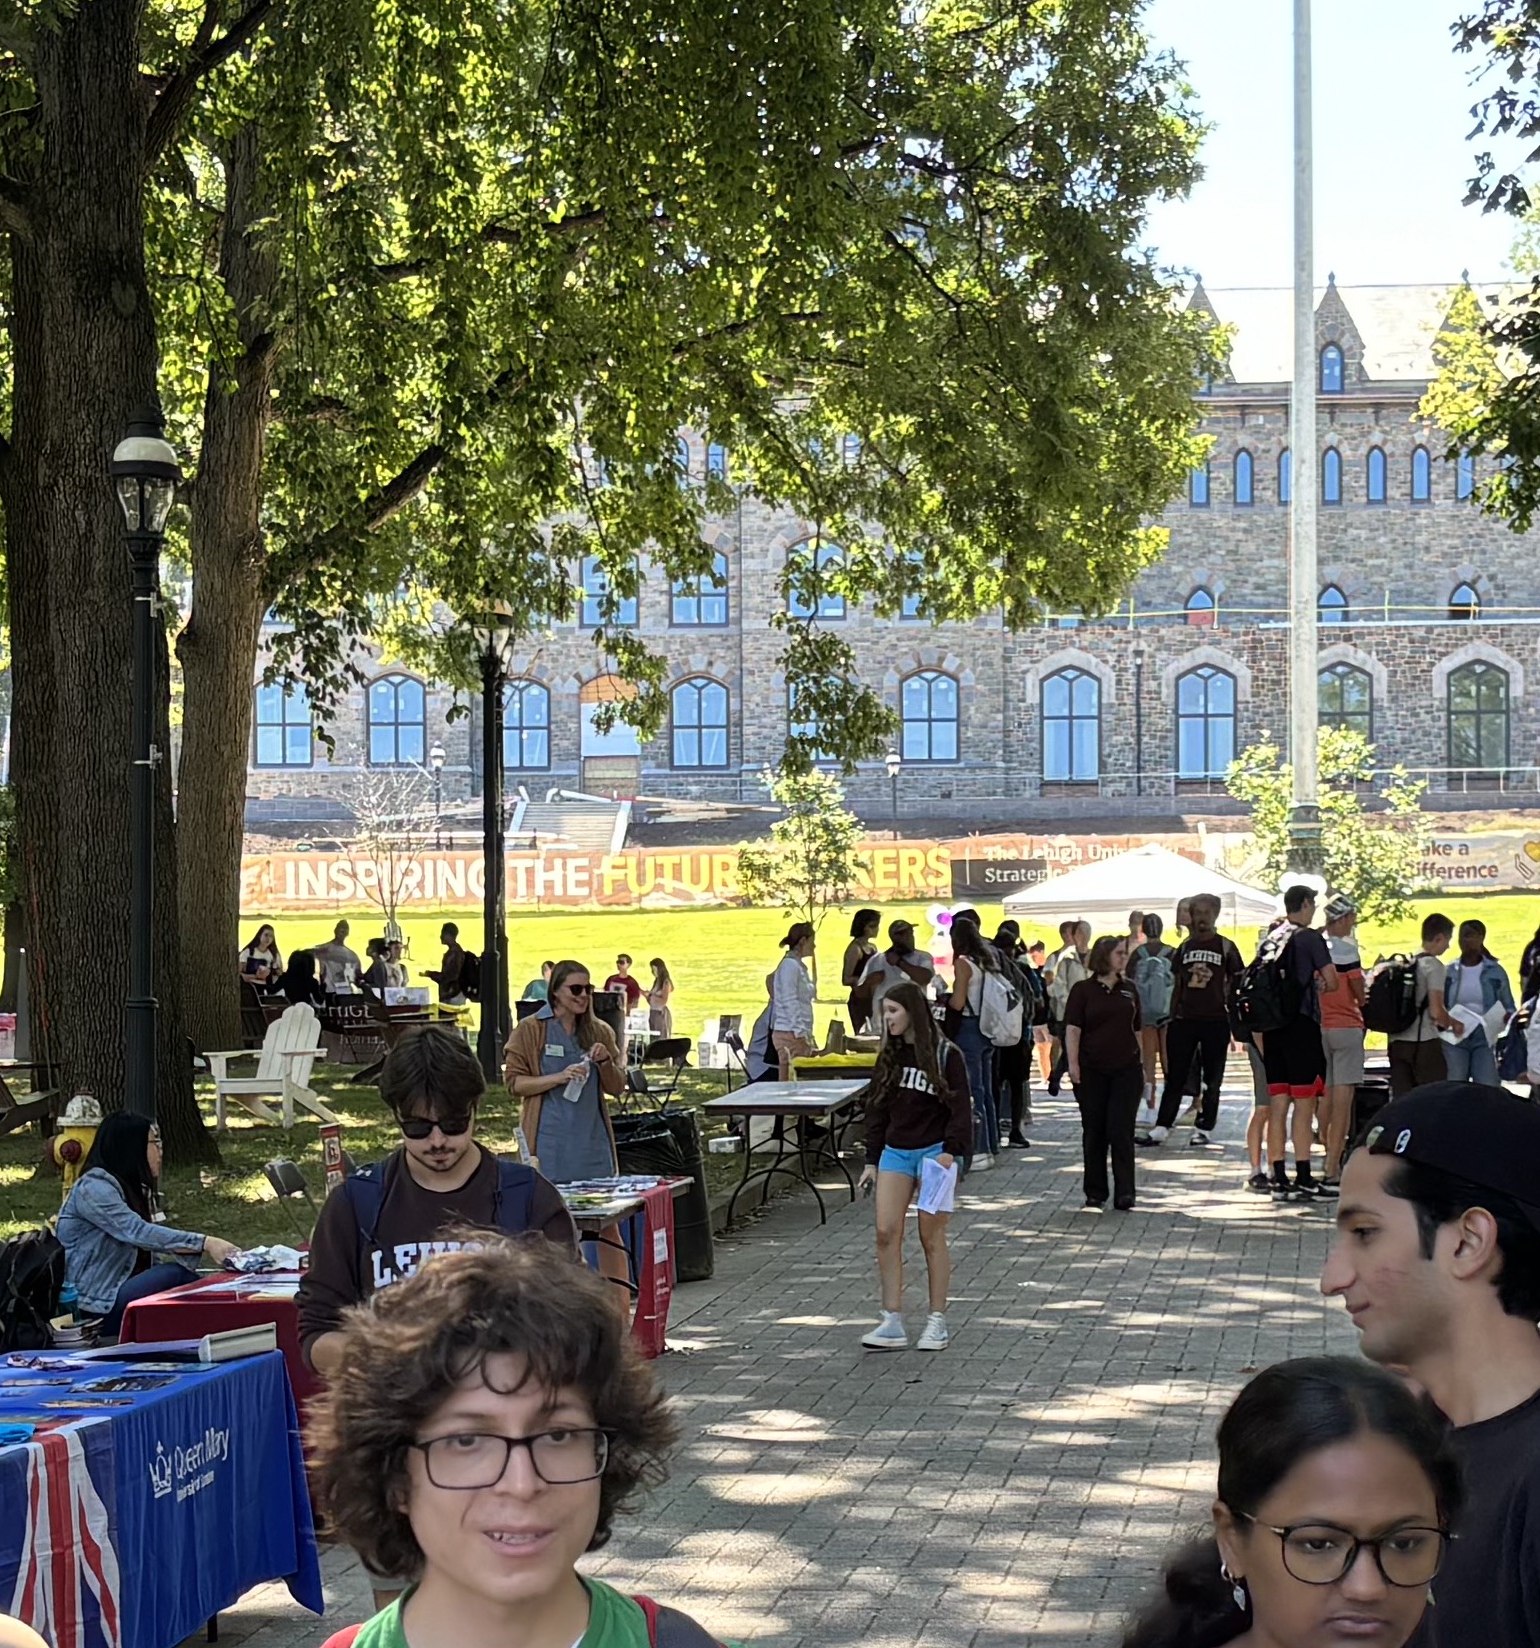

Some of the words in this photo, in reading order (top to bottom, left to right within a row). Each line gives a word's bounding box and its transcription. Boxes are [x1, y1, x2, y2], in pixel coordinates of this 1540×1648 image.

[984, 845, 1018, 861] The
[1021, 843, 1083, 866] Lehigh
[1422, 839, 1453, 857] ake
[1458, 843, 1470, 856] a
[284, 856, 485, 900] INSPIRING
[510, 857, 591, 898] THE
[601, 853, 741, 896] FUTUR
